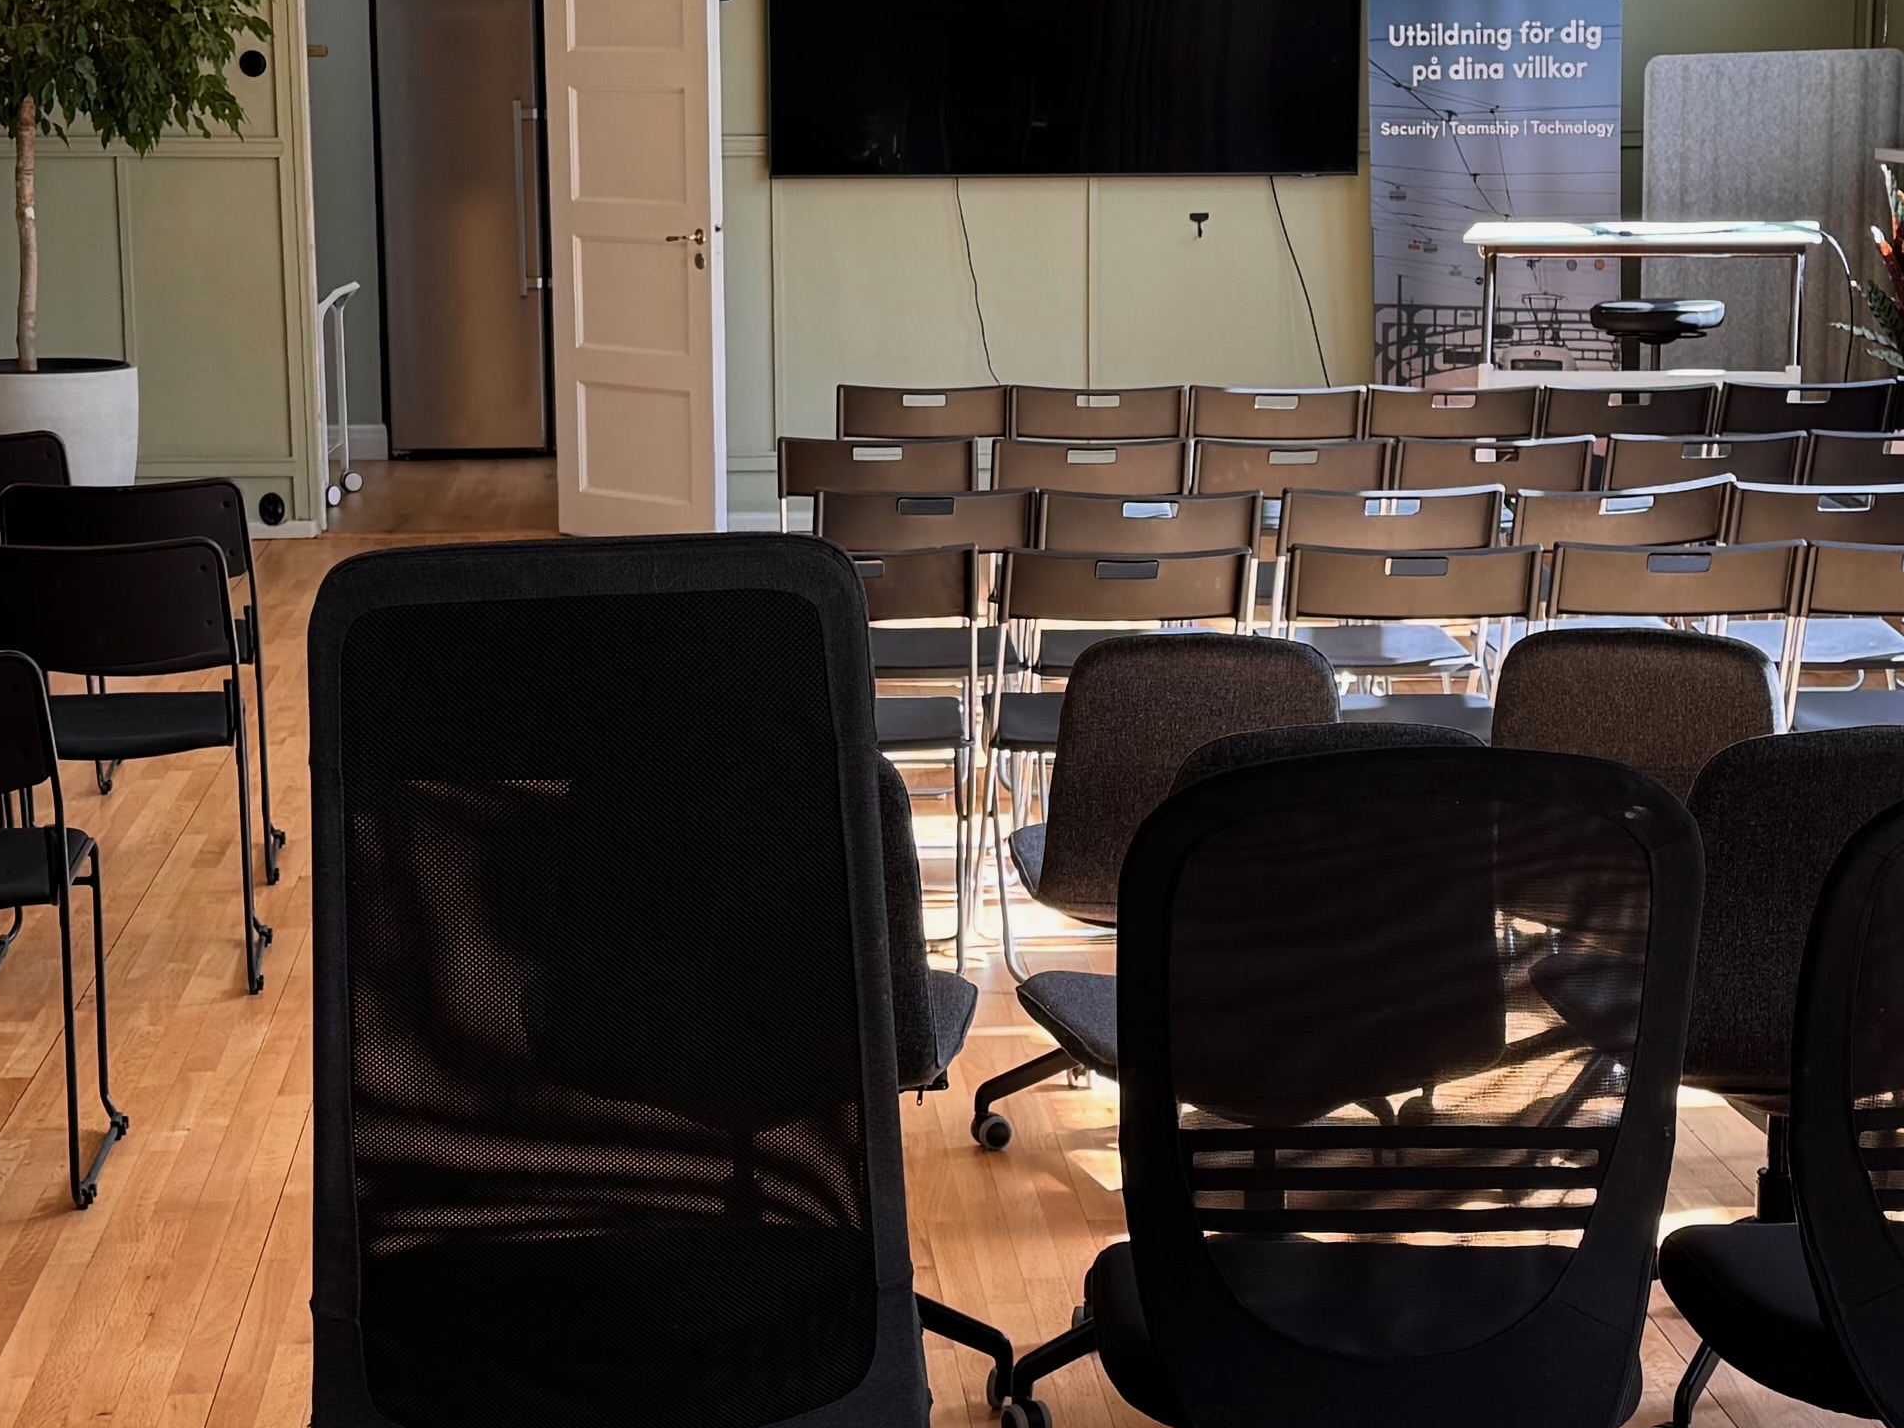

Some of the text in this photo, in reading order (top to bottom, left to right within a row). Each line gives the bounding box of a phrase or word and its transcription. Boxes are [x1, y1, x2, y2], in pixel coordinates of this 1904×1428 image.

[1388, 19, 1602, 51] Utbildning för dig
[1412, 55, 1589, 87] på dina villkor
[1380, 120, 1615, 139] Security Teamship Technology
